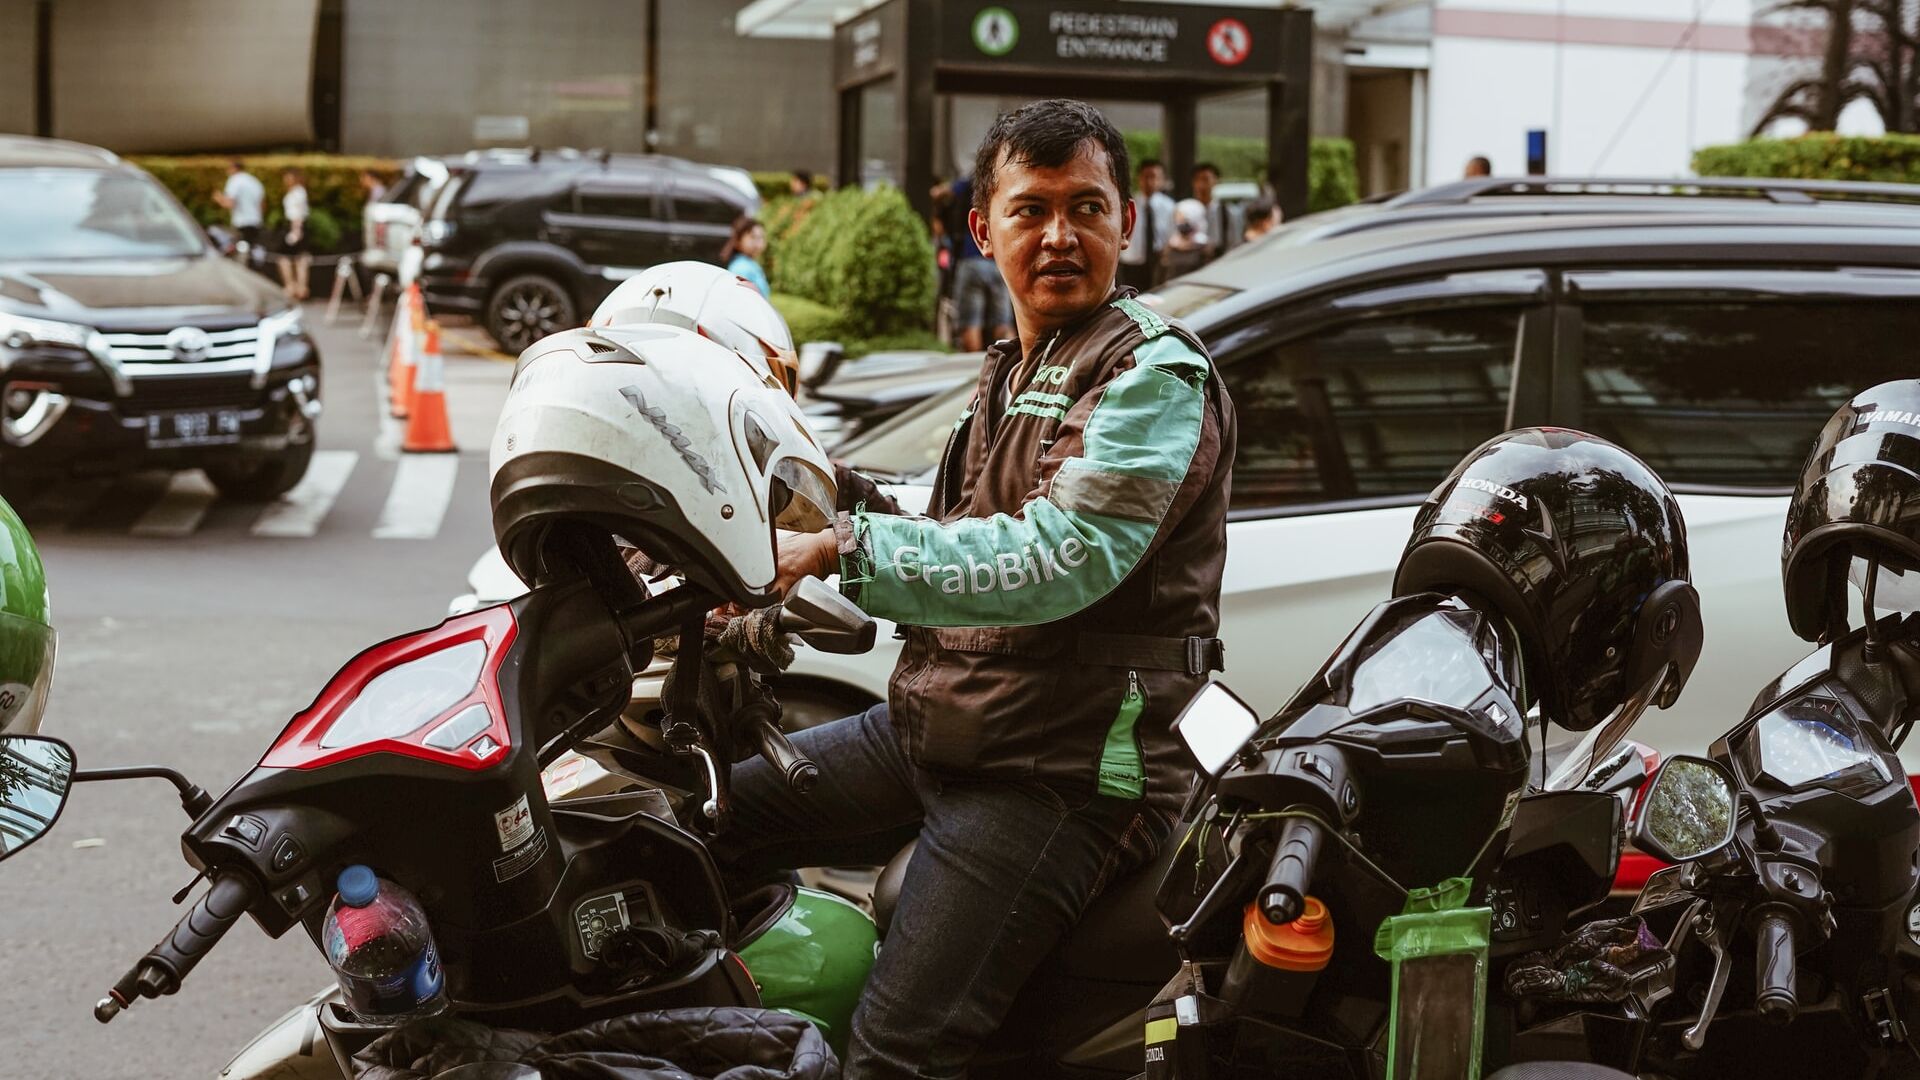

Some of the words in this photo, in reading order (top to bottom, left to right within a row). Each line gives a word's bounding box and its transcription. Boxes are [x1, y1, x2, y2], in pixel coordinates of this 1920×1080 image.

[1049, 11, 1178, 39] PEDESTRIAN
[1056, 35, 1168, 62] ENTRANCE
[1458, 479, 1528, 511] HONDA
[893, 537, 1089, 594] GrabBike
